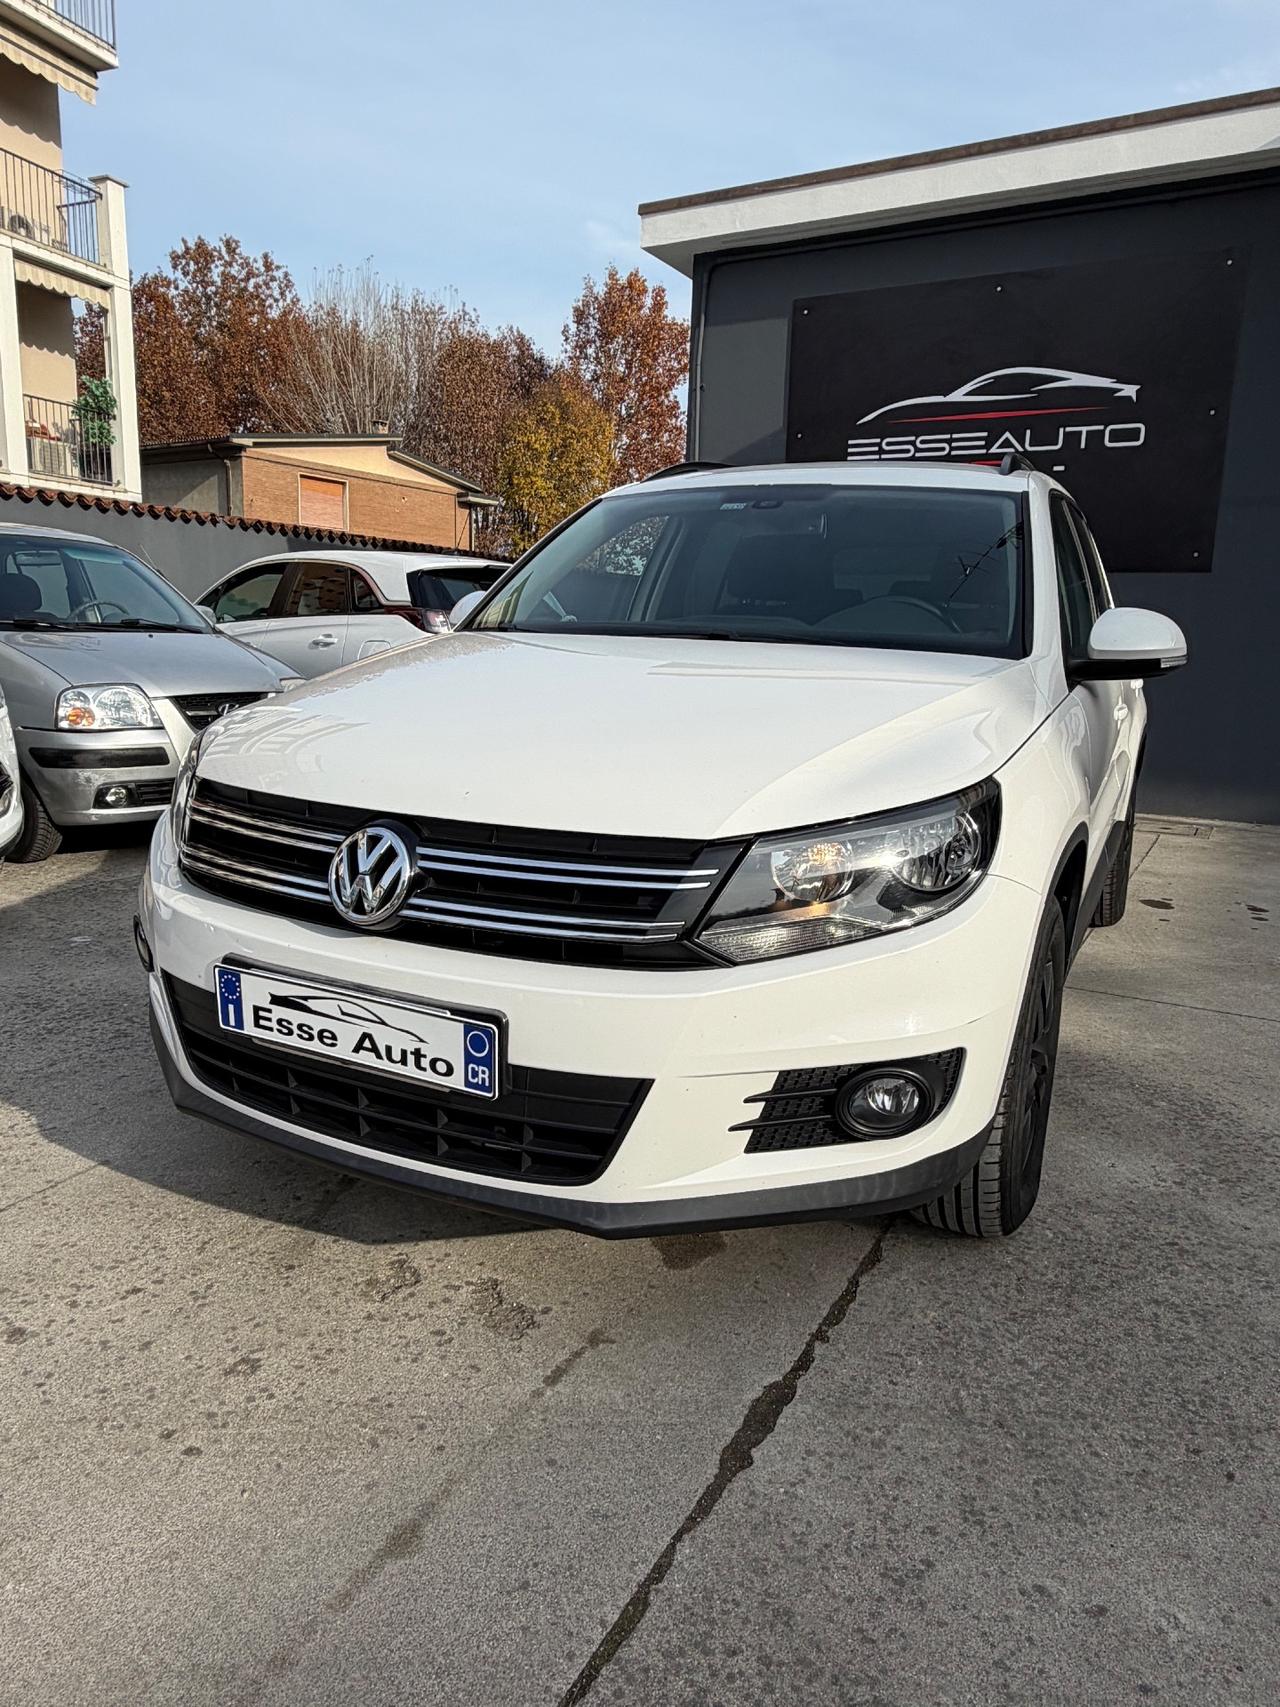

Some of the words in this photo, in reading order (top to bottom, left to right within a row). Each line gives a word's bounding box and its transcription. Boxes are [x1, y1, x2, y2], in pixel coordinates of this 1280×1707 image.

[847, 422, 1146, 460] ESSEAUTO
[329, 827, 410, 924] VW
[252, 1004, 338, 1048] Esse
[351, 1031, 455, 1077] Auto
[467, 1063, 490, 1087] CR
